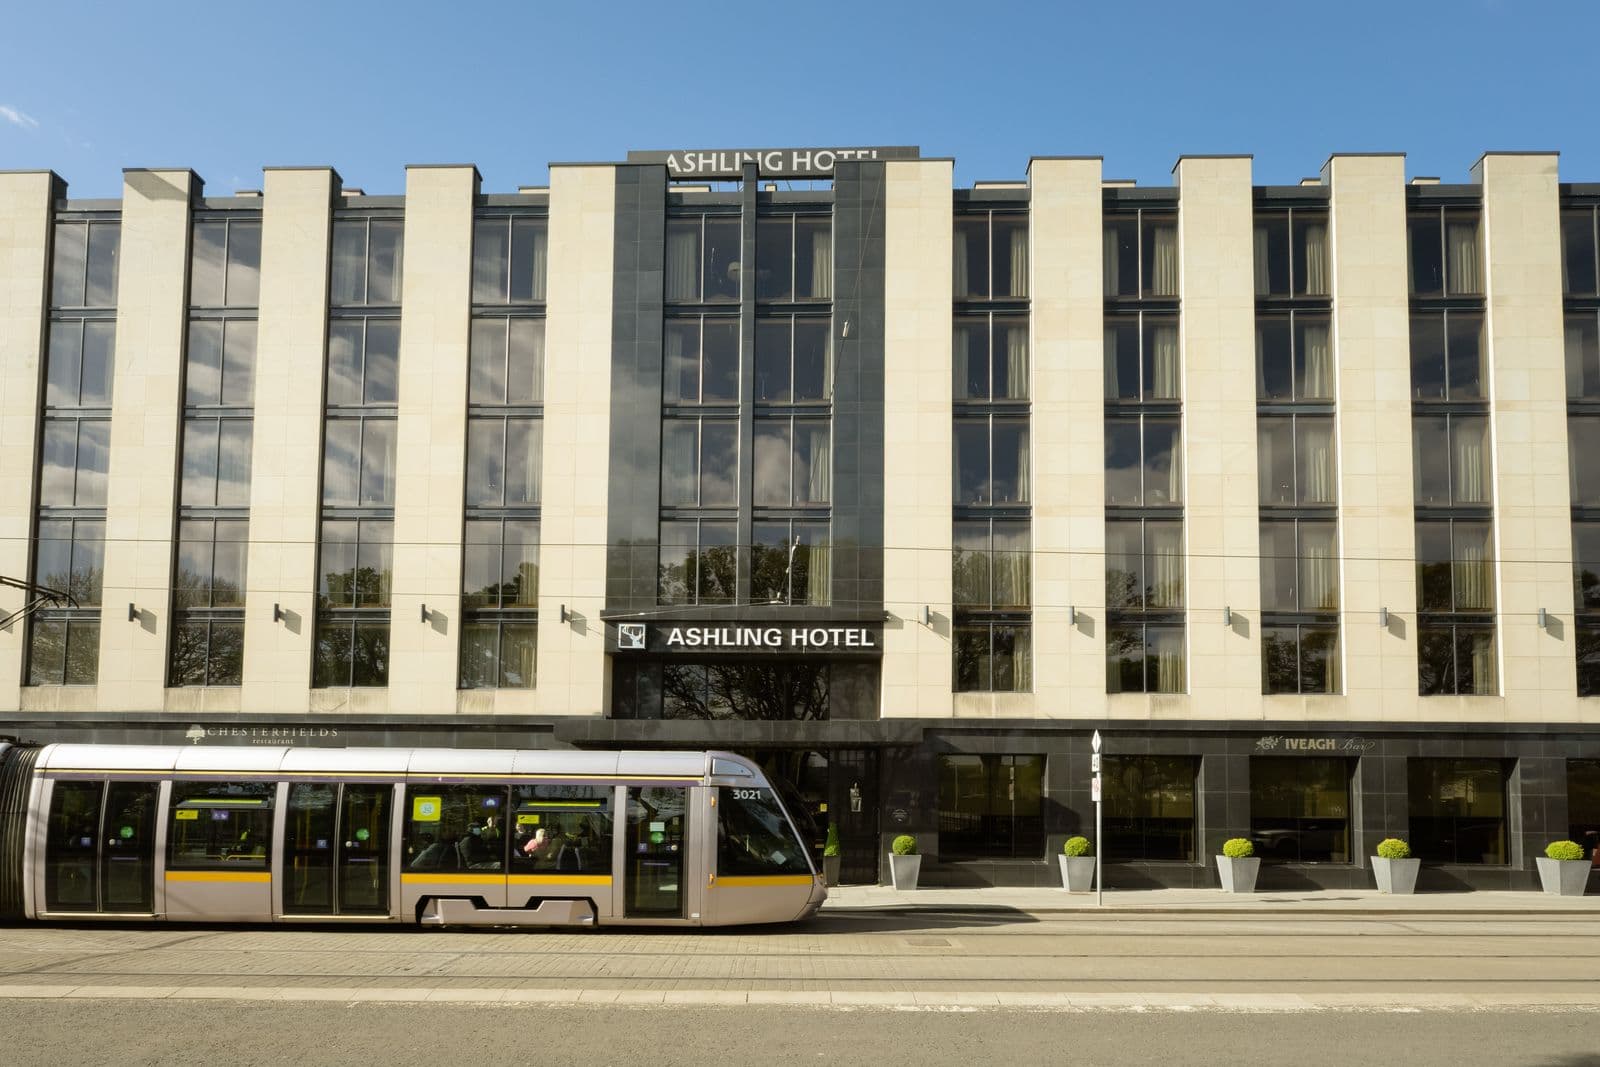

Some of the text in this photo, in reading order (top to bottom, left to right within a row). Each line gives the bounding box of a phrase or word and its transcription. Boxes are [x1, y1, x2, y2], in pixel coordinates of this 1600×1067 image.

[667, 151, 783, 172] ASHLING
[667, 627, 875, 647] ASHLING HOTEL
[207, 727, 338, 737] CHESTERFIELDS
[1285, 736, 1376, 751] IVEAGH Bar
[733, 789, 761, 799] 3021
